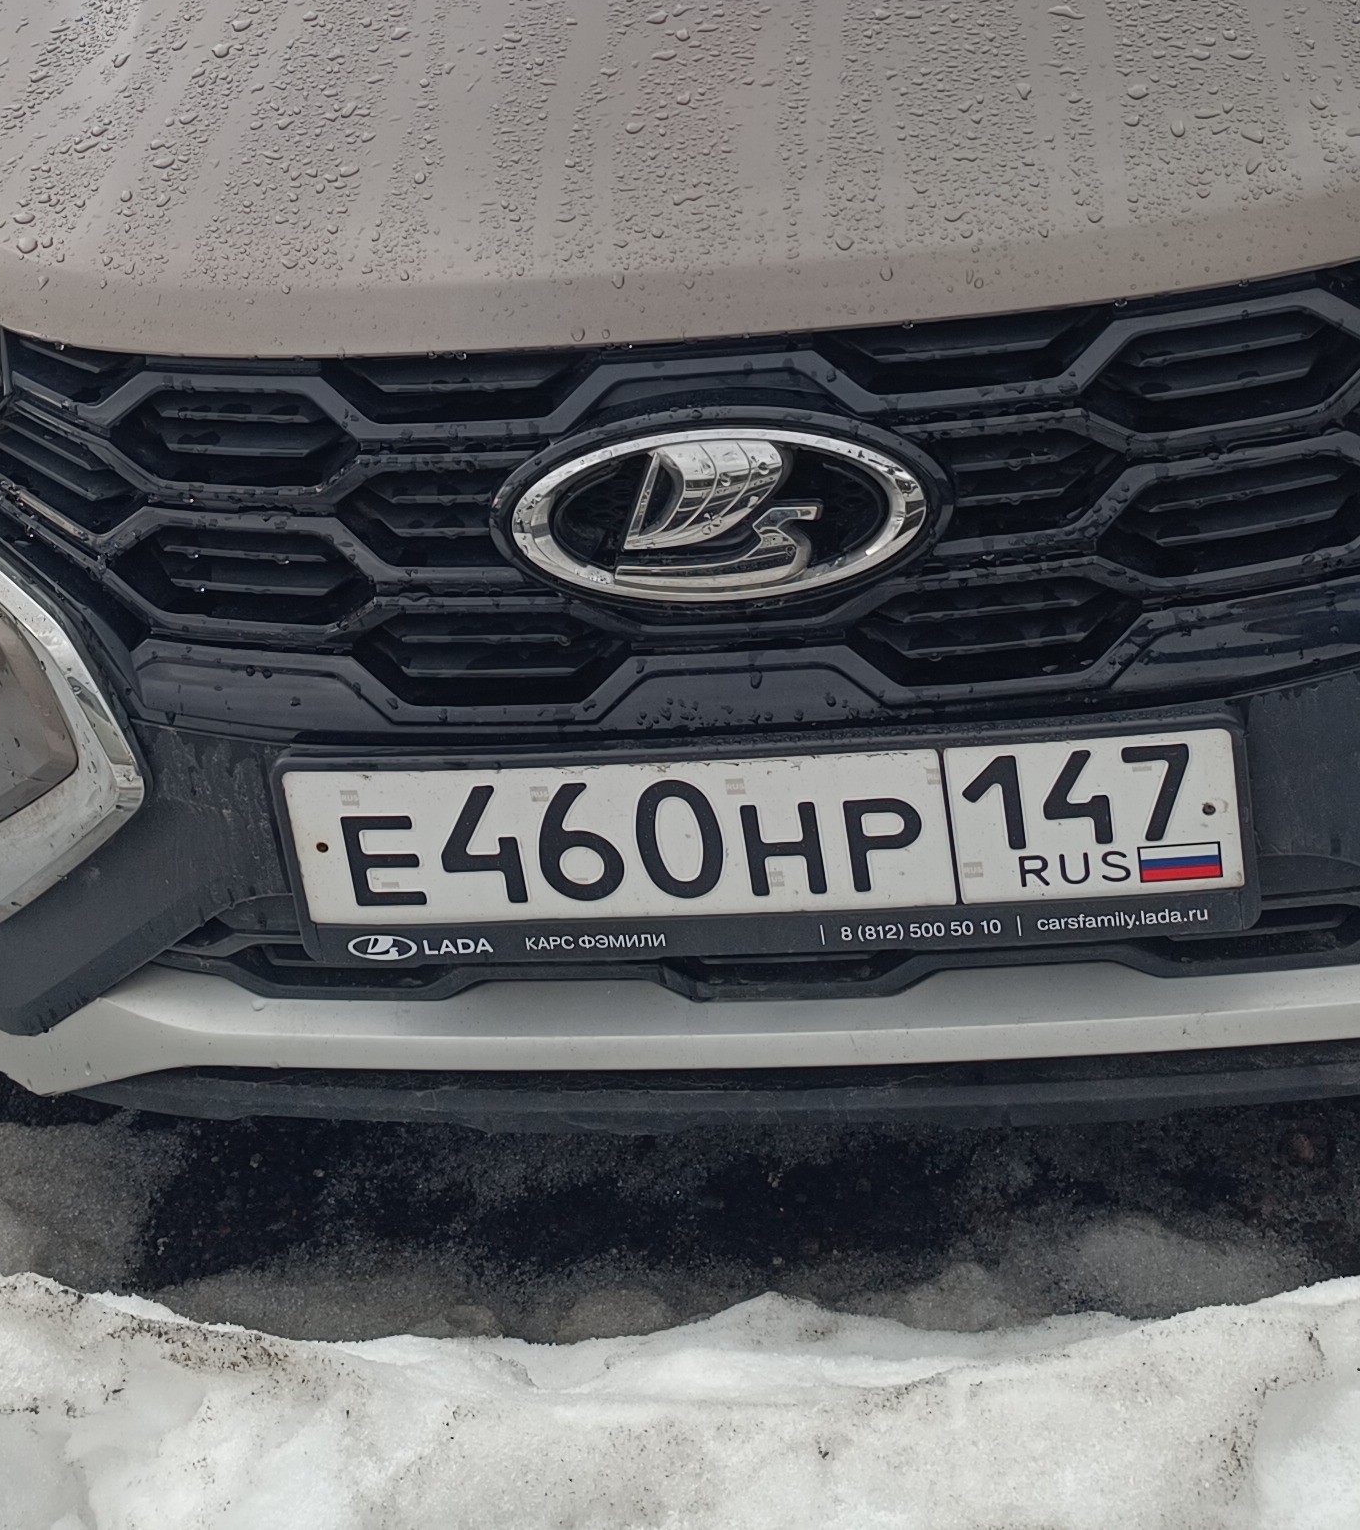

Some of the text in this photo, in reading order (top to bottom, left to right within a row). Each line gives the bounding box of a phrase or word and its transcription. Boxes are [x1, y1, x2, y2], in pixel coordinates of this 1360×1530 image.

[339, 742, 1190, 907] Е460НР 147
[1018, 850, 1132, 888] RUS
[840, 919, 1002, 942] 8 (812) 500 50 10
[1037, 909, 1209, 931] carsfamily.lada.ru
[422, 937, 494, 955] LADA
[525, 933, 666, 951] КАРС ФЭМИЛИ
